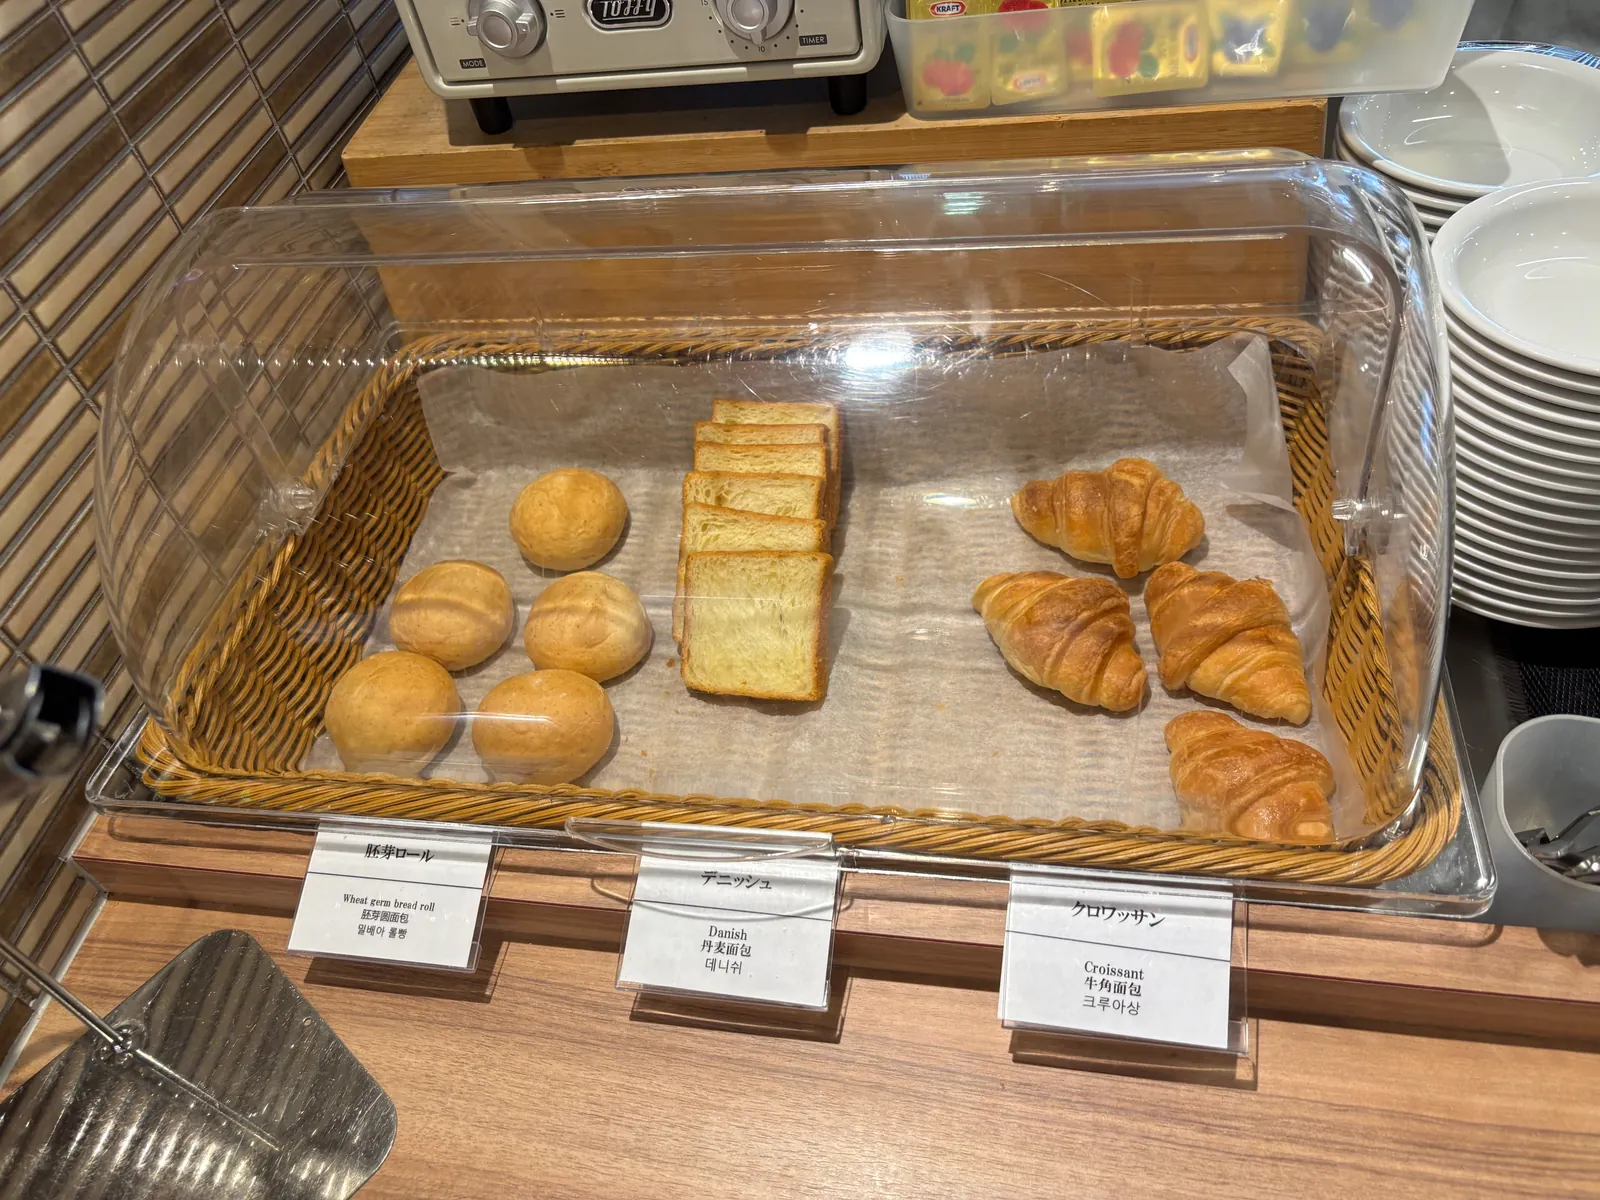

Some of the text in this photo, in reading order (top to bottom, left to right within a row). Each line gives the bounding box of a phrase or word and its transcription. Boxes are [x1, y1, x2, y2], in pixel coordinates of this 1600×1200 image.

[936, 5, 960, 13] KRAFT
[802, 36, 825, 44] TIMER
[364, 843, 435, 863] 胚芽ロール
[701, 870, 772, 890] デニッシュ
[343, 893, 435, 912] Wheat germ bread roll
[1070, 900, 1166, 927] クロワッサン
[708, 925, 748, 941] Danish
[700, 940, 752, 958] 丹麦面包
[705, 958, 743, 975] 데니쉬
[1084, 960, 1144, 980] Croissant
[1084, 976, 1142, 997] 牛角面包
[1082, 995, 1140, 1015] 크루아상
